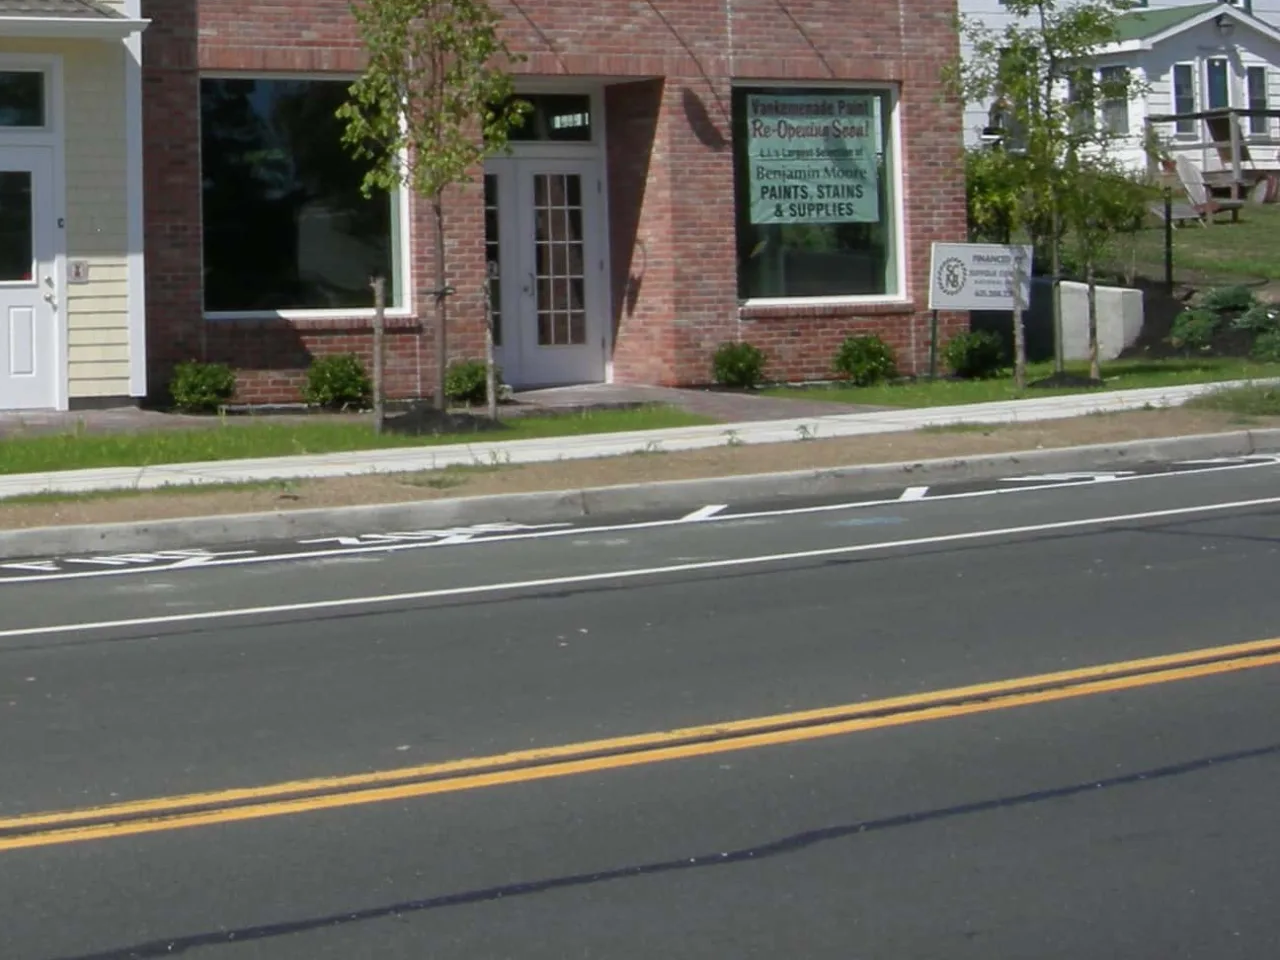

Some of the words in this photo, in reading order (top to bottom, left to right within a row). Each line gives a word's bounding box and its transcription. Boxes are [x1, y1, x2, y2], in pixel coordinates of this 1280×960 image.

[756, 164, 819, 182] Benjamin
[824, 166, 867, 180] Moore
[761, 185, 813, 200] PAINTS,
[816, 184, 864, 199] STAINS
[774, 203, 783, 217] &
[789, 202, 854, 217] SUPPLIES
